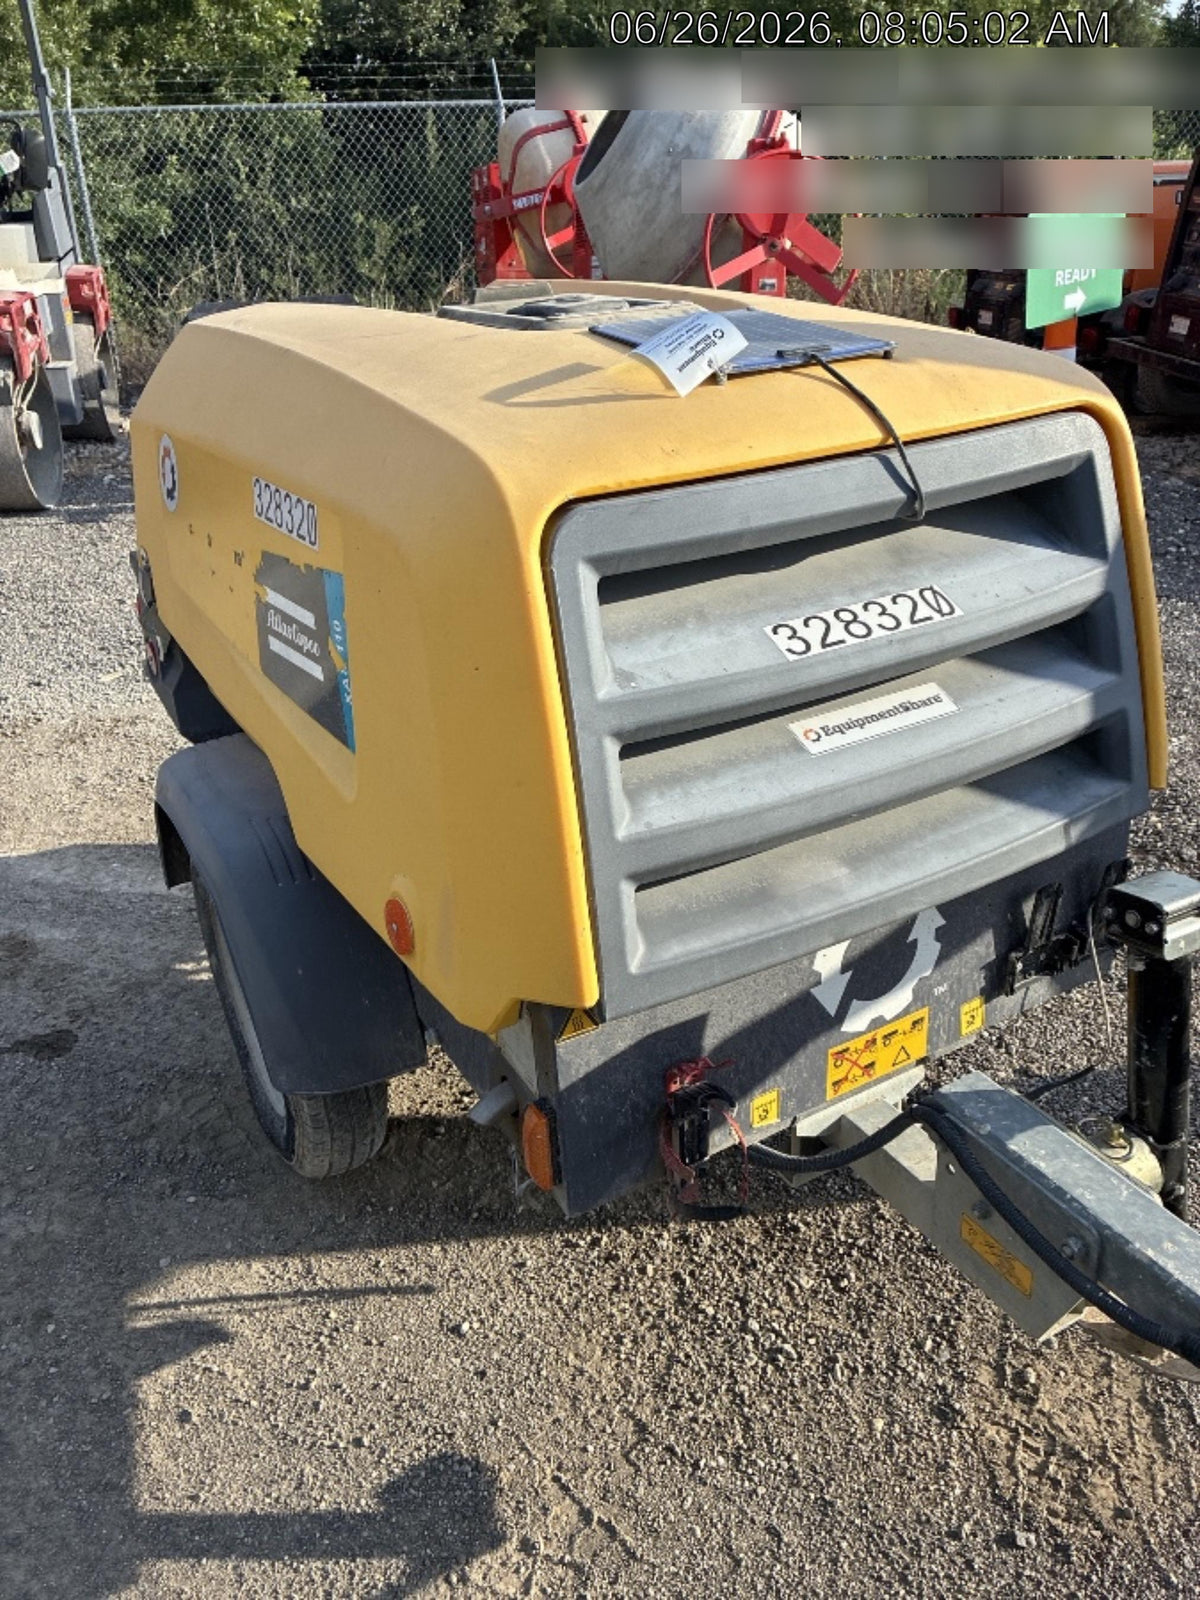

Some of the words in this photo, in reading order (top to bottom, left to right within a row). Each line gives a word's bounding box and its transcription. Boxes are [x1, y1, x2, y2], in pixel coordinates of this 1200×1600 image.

[253, 477, 317, 546] 328320
[772, 584, 955, 656] 328320
[820, 692, 944, 738] EquipmentShare
